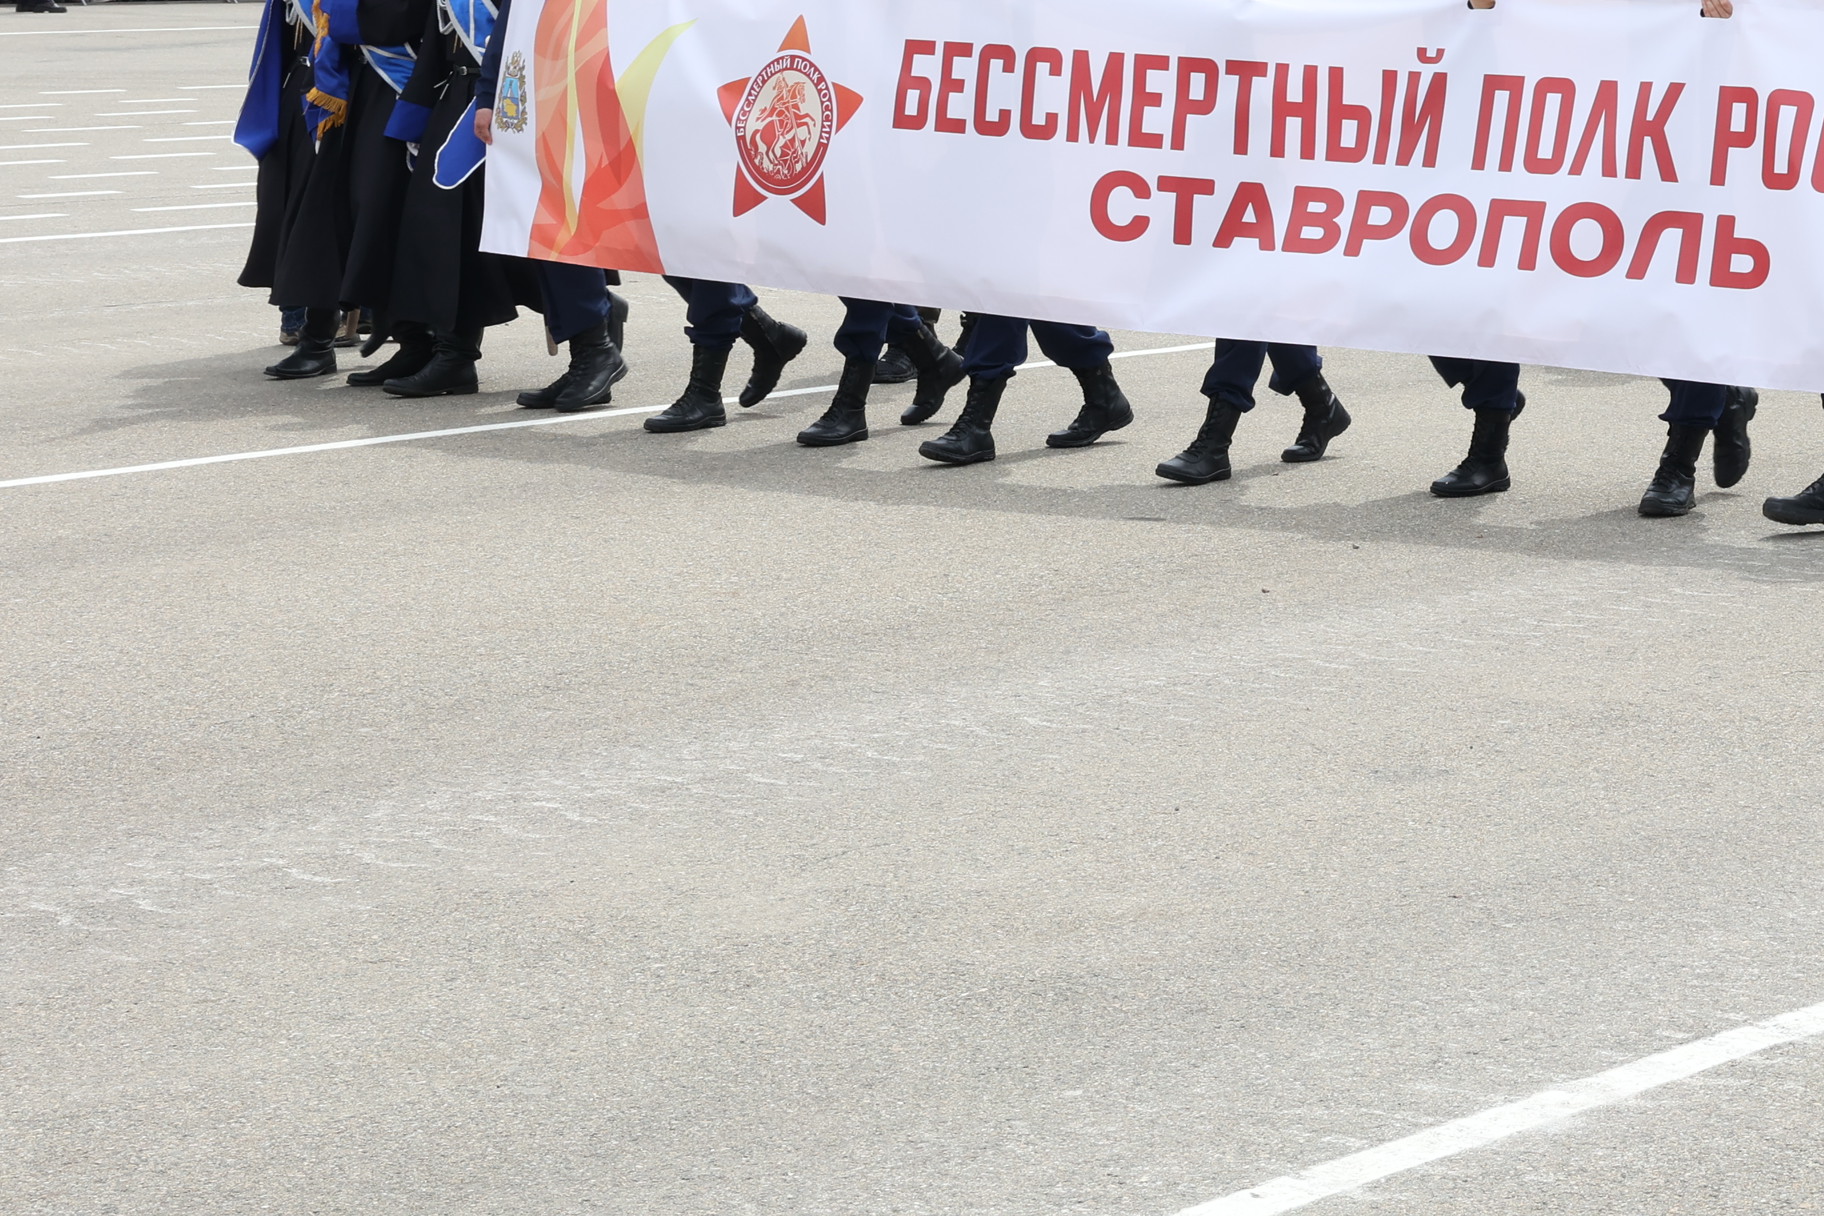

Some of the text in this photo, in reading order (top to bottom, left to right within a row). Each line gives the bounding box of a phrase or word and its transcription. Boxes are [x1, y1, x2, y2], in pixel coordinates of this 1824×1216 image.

[736, 56, 832, 144] БЕССМЕРТНЫЙ ПОЛК РОССИИ
[894, 40, 1446, 171] БЕССМЕРТНЫЙ
[1473, 74, 1684, 182] ПОЛК
[1091, 170, 1770, 290] СТАВРОПОЛЬ
